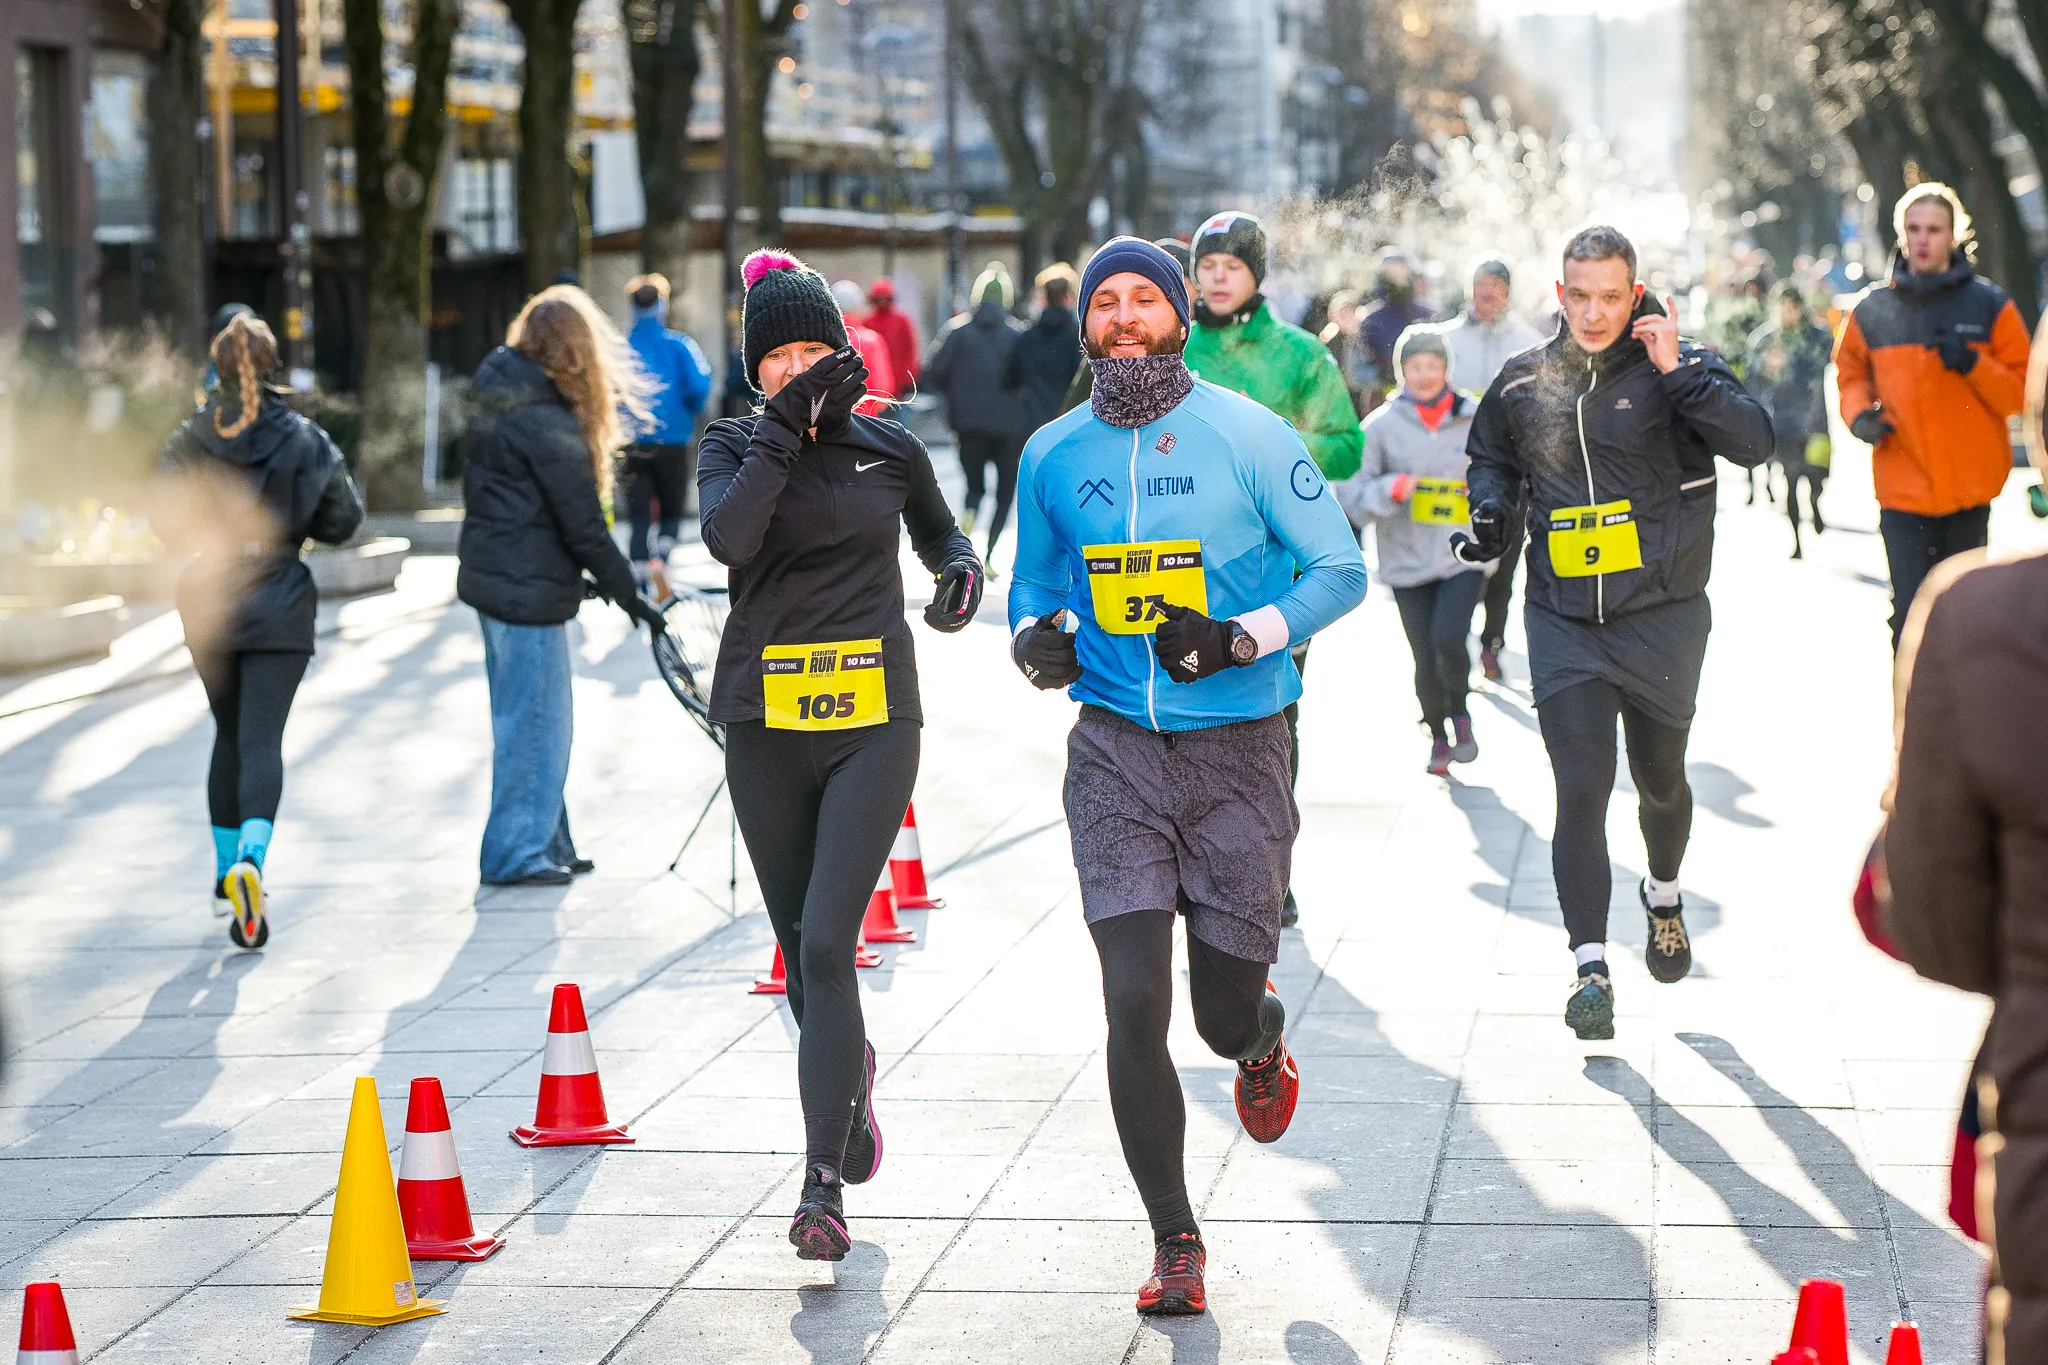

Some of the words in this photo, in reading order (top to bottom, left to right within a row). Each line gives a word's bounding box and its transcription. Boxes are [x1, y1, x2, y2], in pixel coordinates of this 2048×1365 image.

[1147, 476, 1194, 496] LIETUVA
[1163, 557, 1176, 566] 10
[1177, 556, 1194, 565] km
[1585, 546, 1600, 565] 9
[1126, 556, 1151, 574] RUN
[1125, 594, 1164, 622] 37
[776, 662, 798, 670] VIPZONE
[809, 656, 837, 673] RUN
[846, 657, 858, 666] 10
[859, 656, 876, 665] km
[797, 692, 856, 719] 105
